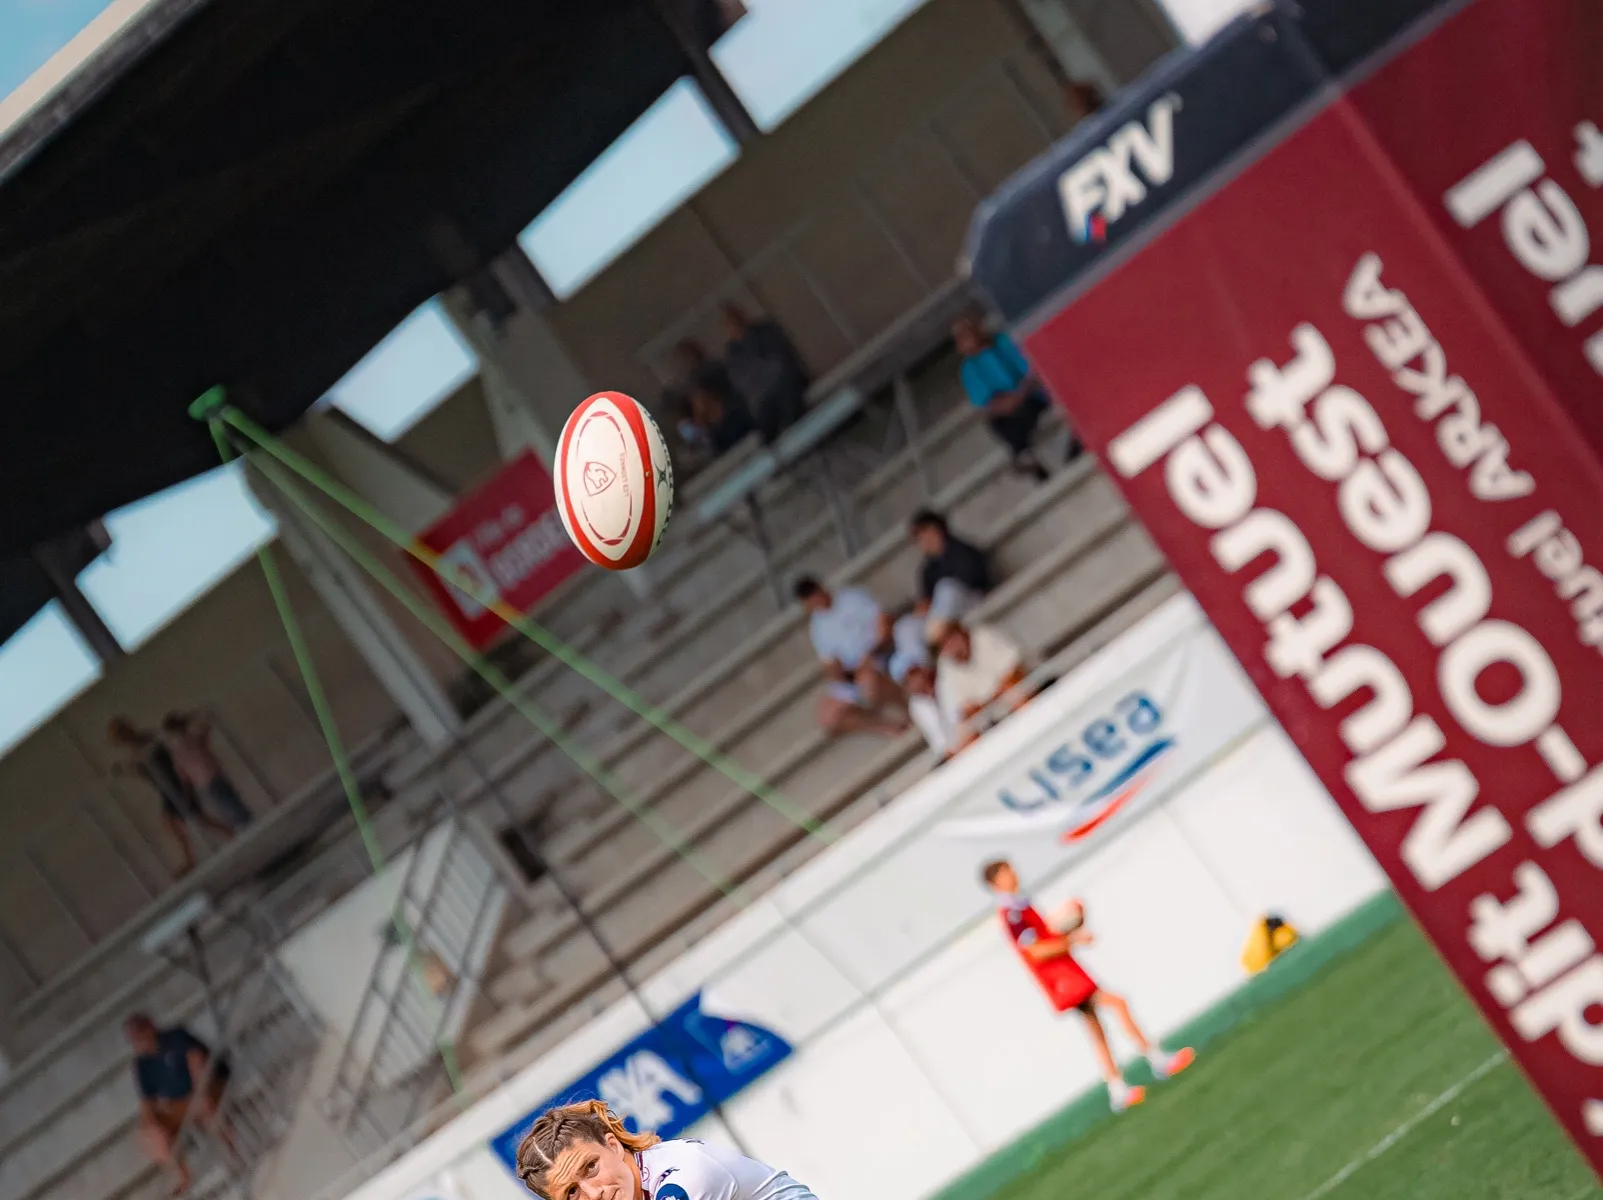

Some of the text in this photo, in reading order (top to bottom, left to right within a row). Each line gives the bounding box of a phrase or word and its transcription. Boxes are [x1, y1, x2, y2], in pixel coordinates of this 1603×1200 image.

[1343, 252, 1536, 501] ARKEA
[1106, 383, 1603, 1135] dit Mutuel
